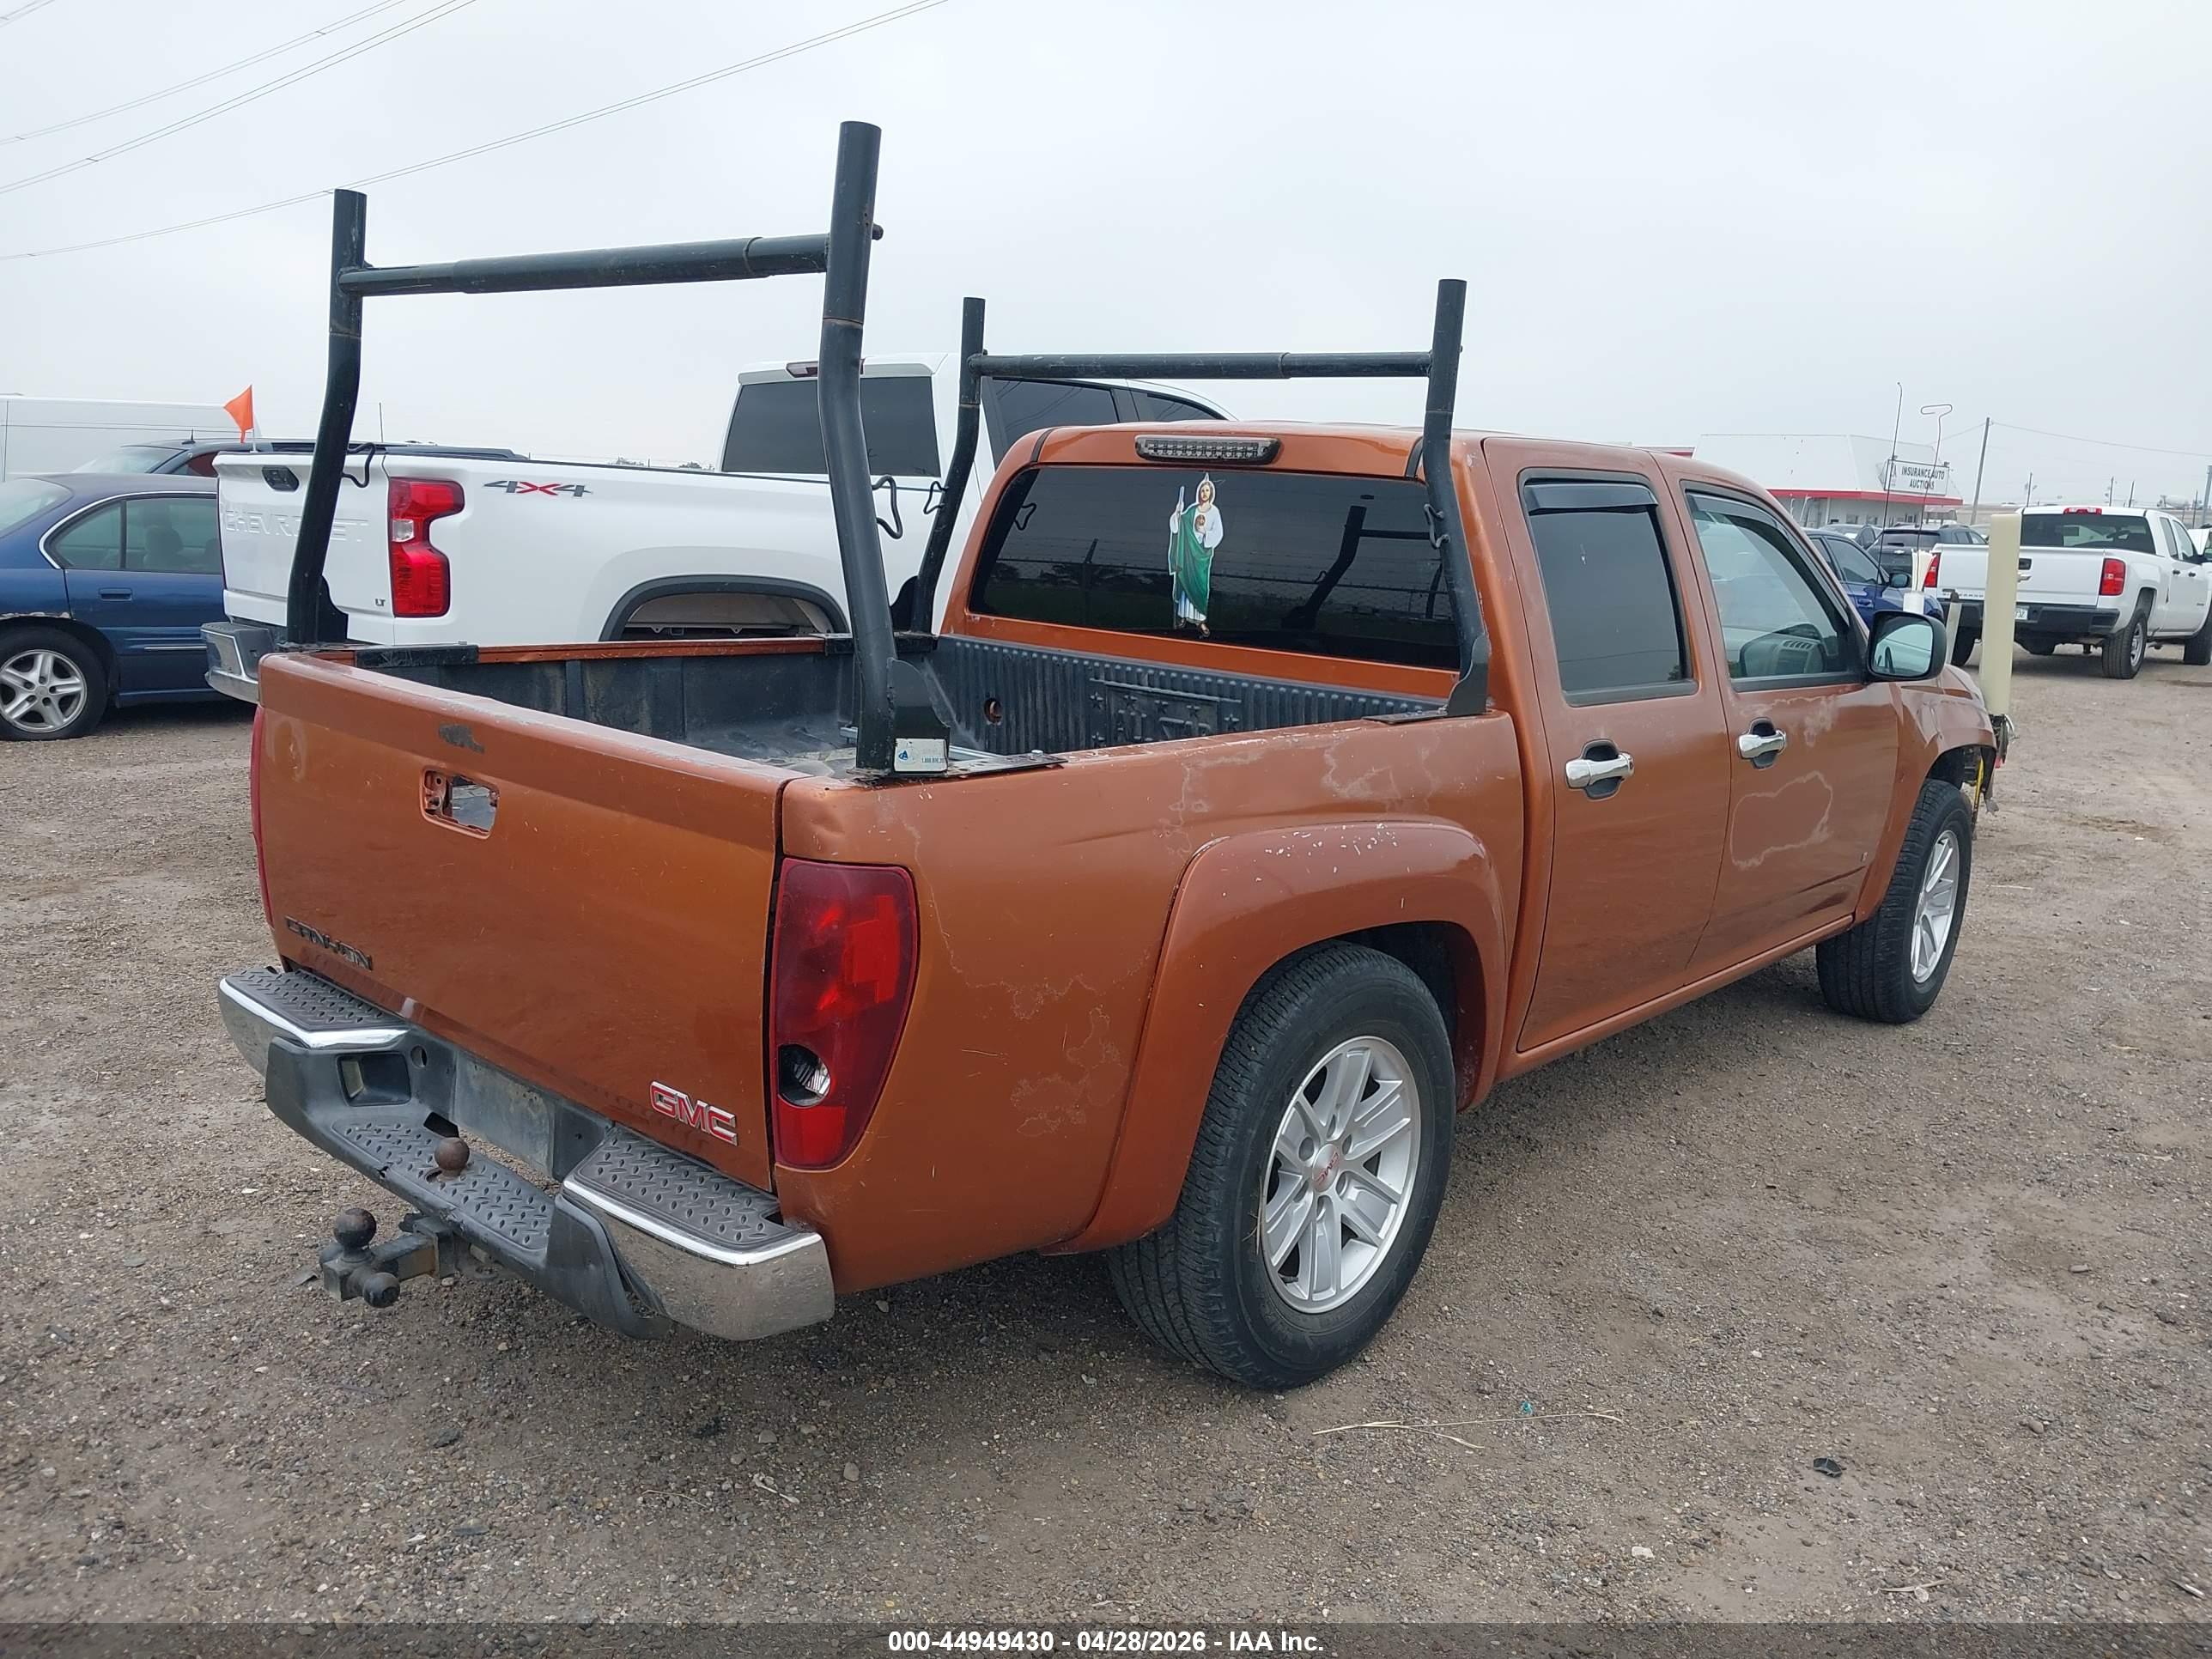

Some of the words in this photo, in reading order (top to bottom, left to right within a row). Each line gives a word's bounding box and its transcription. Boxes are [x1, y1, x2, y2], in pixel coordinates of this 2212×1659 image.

[1901, 466, 1930, 478] INSURANCE
[1931, 469, 1945, 480] AUTO
[1910, 479, 1935, 489] AUCTIONS
[225, 510, 369, 542] CHEVRET
[374, 598, 386, 607] LT
[285, 915, 373, 971] CANYON
[650, 1081, 738, 1146] GMC
[1315, 1152, 1340, 1186] GMC
